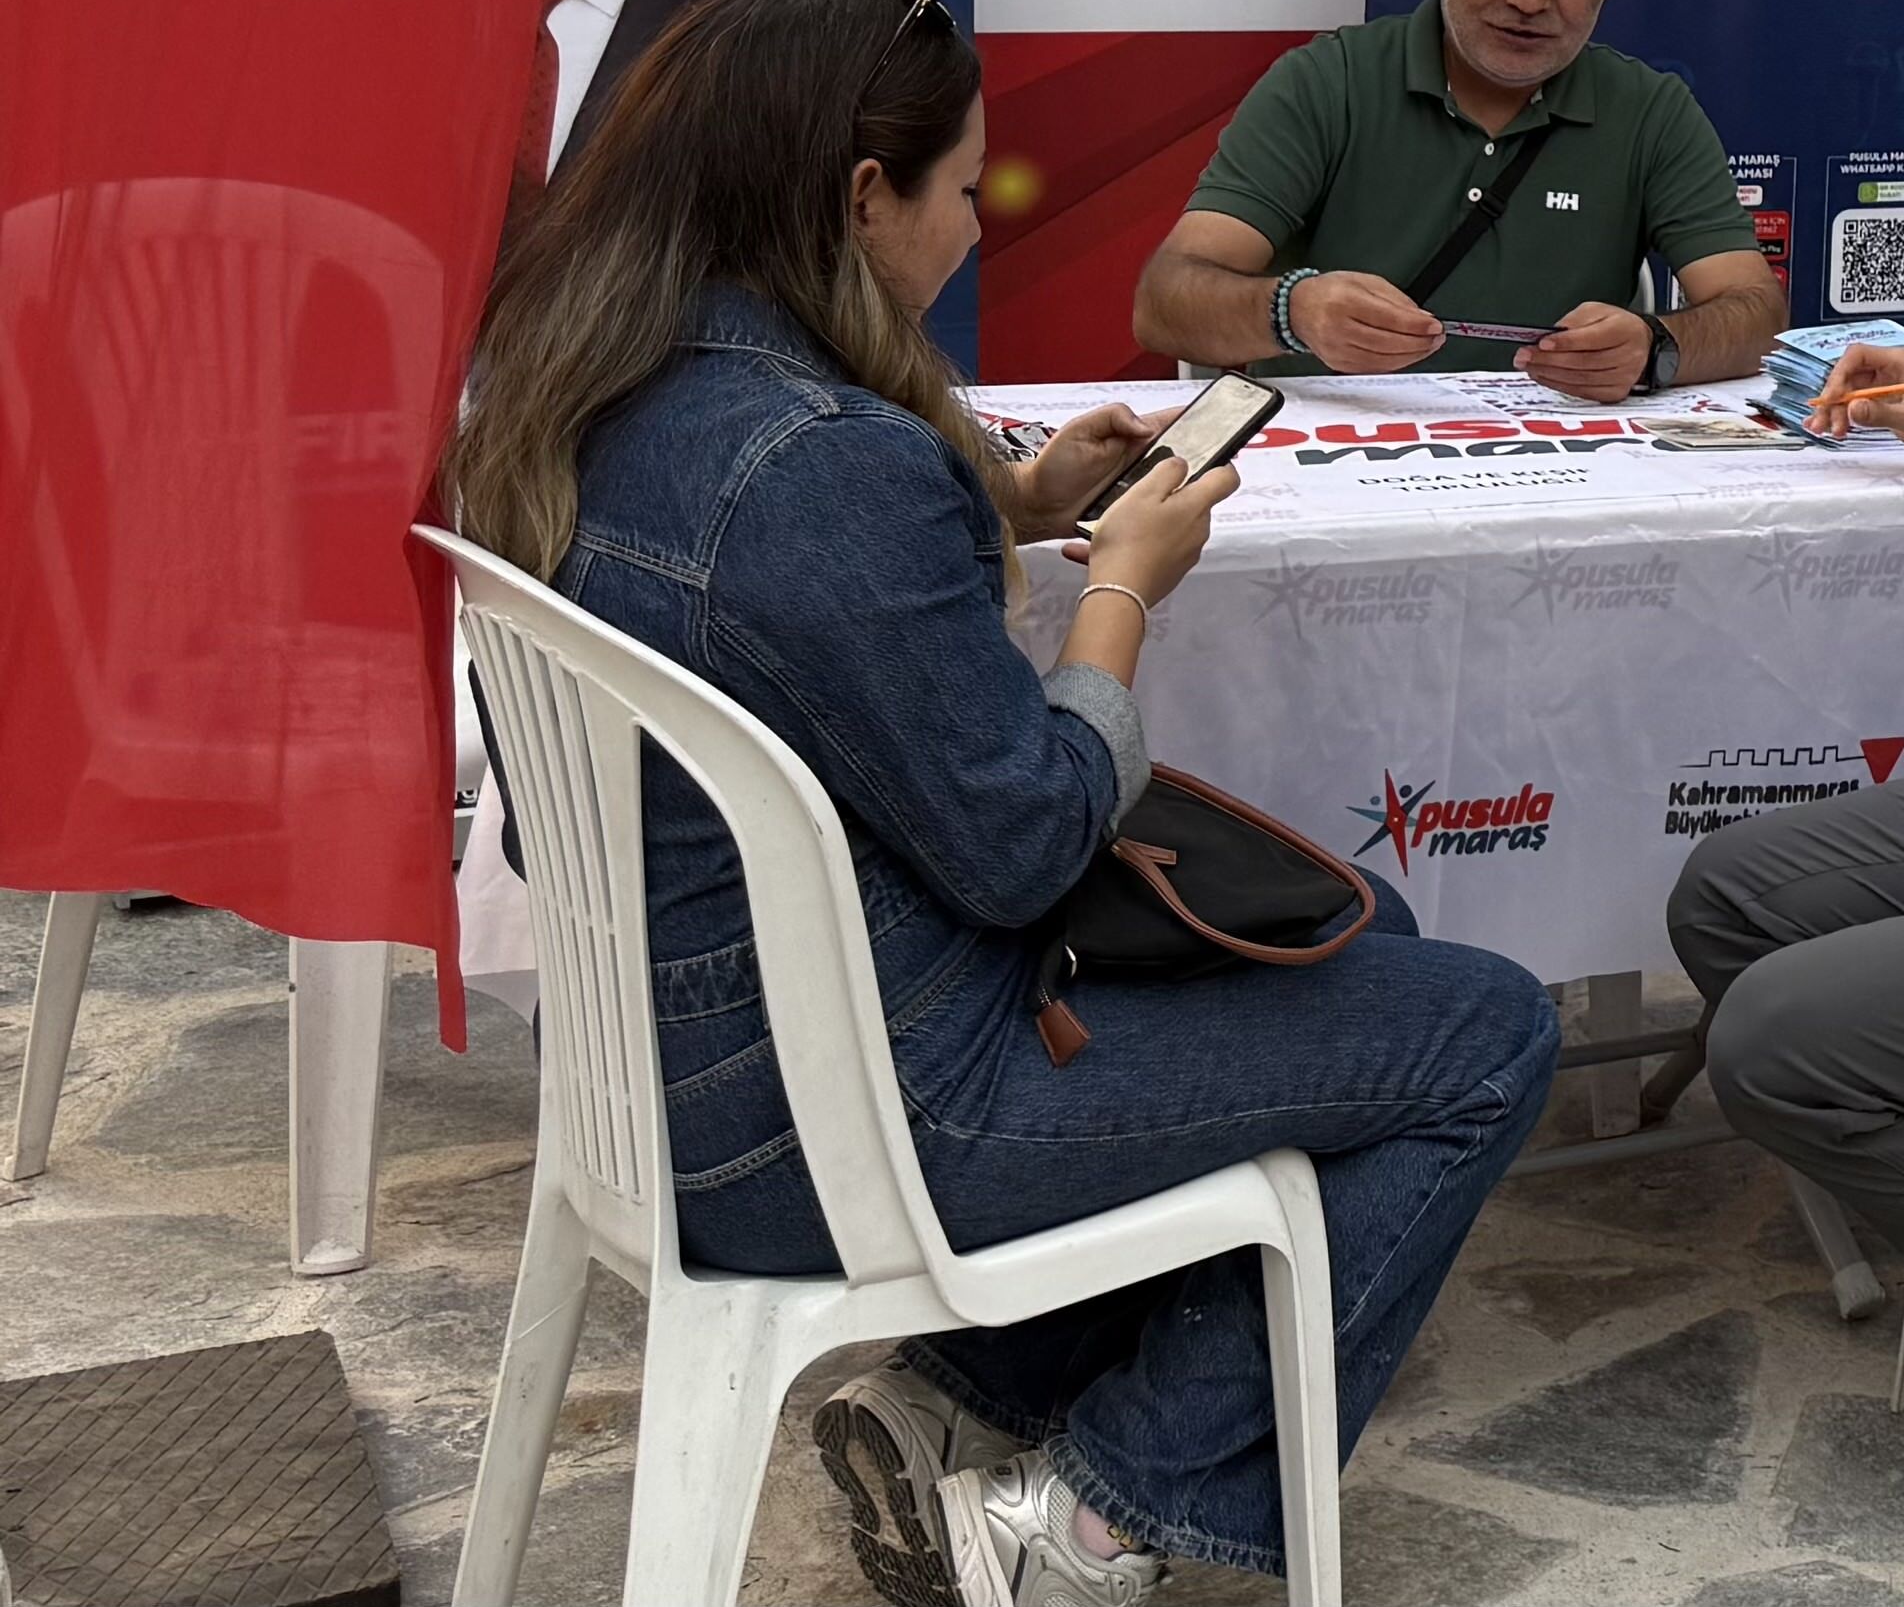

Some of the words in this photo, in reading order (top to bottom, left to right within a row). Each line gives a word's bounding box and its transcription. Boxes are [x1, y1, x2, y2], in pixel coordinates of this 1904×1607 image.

[1545, 191, 1579, 211] HH
[1411, 783, 1554, 847] pusula
[1428, 822, 1549, 858] maraş
